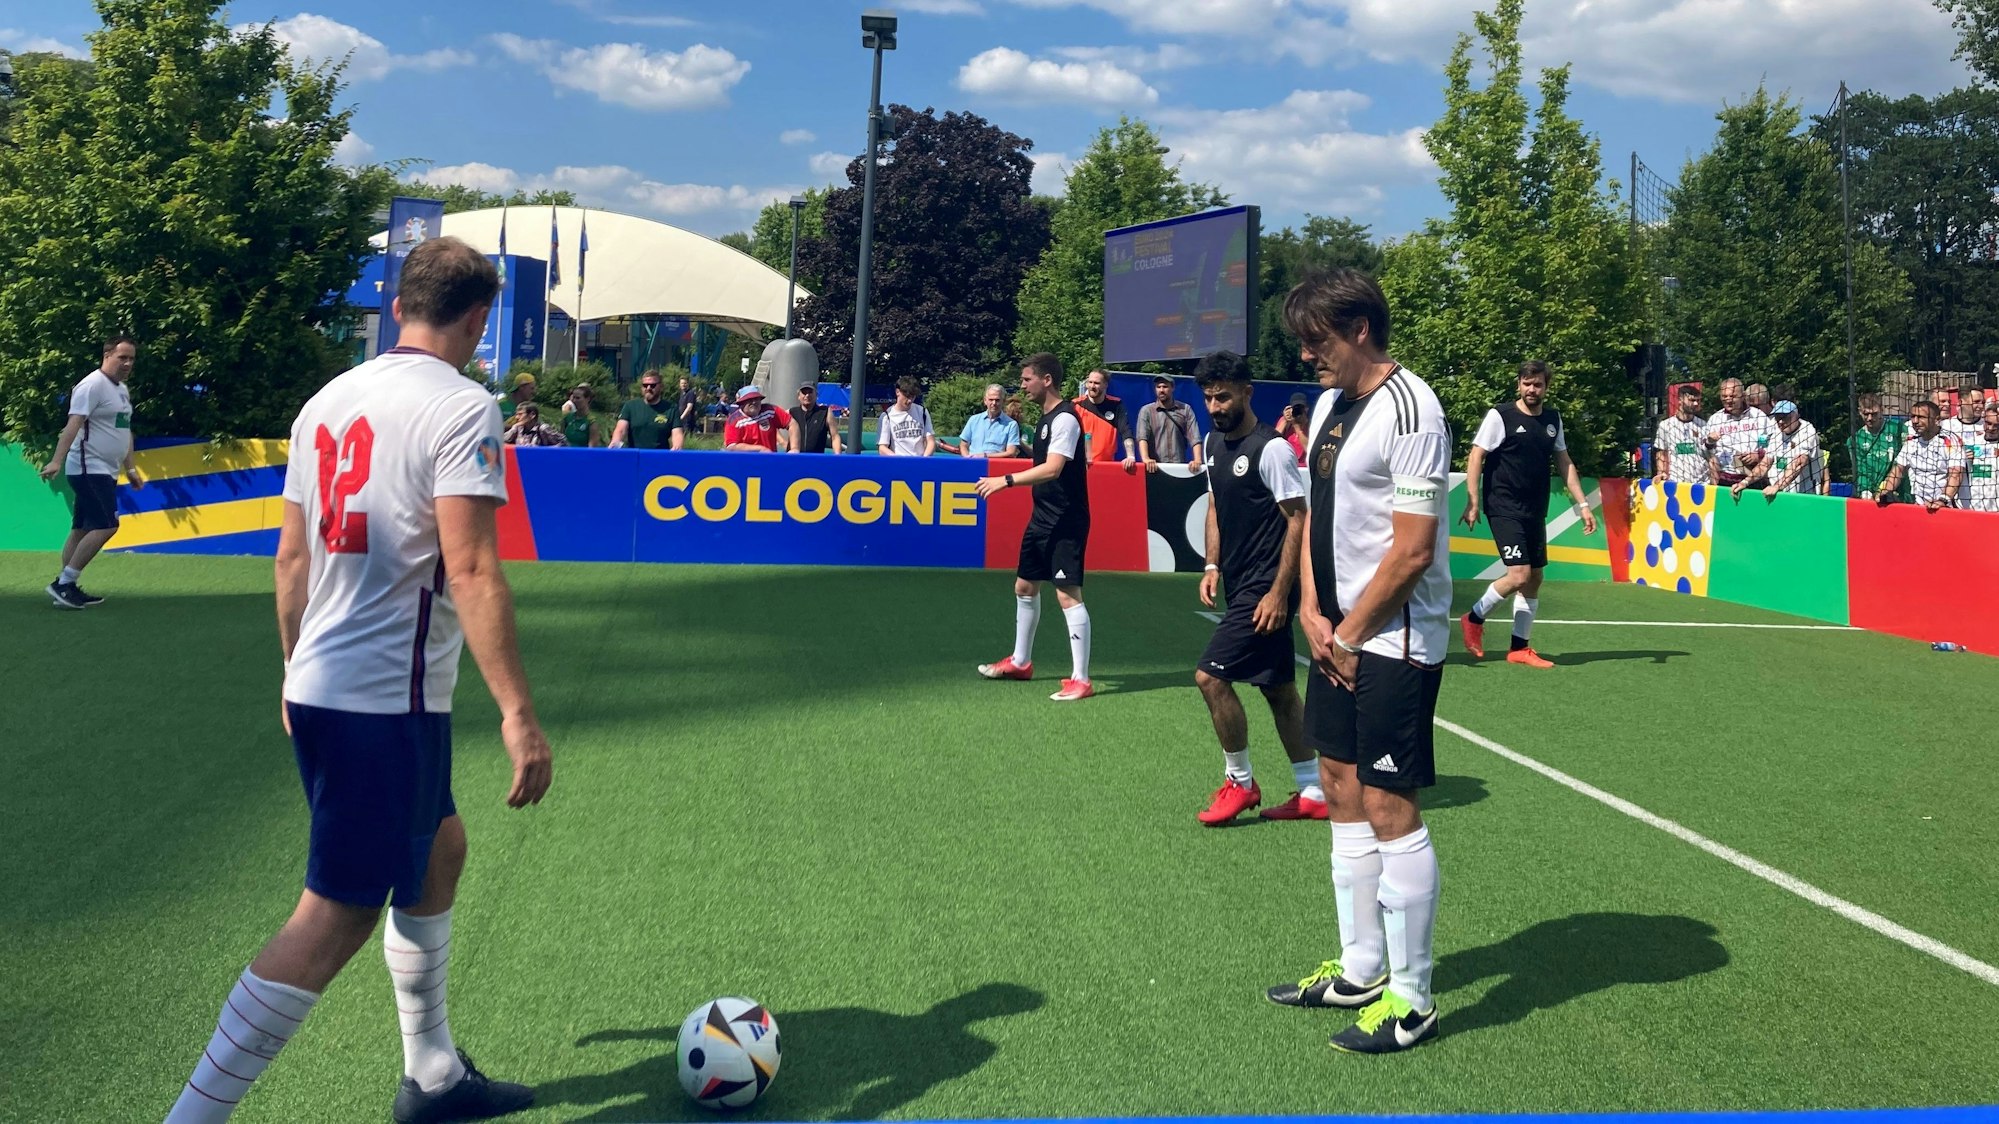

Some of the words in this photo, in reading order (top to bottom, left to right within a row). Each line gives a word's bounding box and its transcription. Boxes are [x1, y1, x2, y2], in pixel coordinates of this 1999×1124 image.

[1134, 254, 1174, 272] COLOGNE
[314, 416, 375, 555] 12
[1396, 486, 1437, 500] RESPECT
[643, 474, 978, 527] COLOGNE
[1503, 544, 1523, 559] 24
